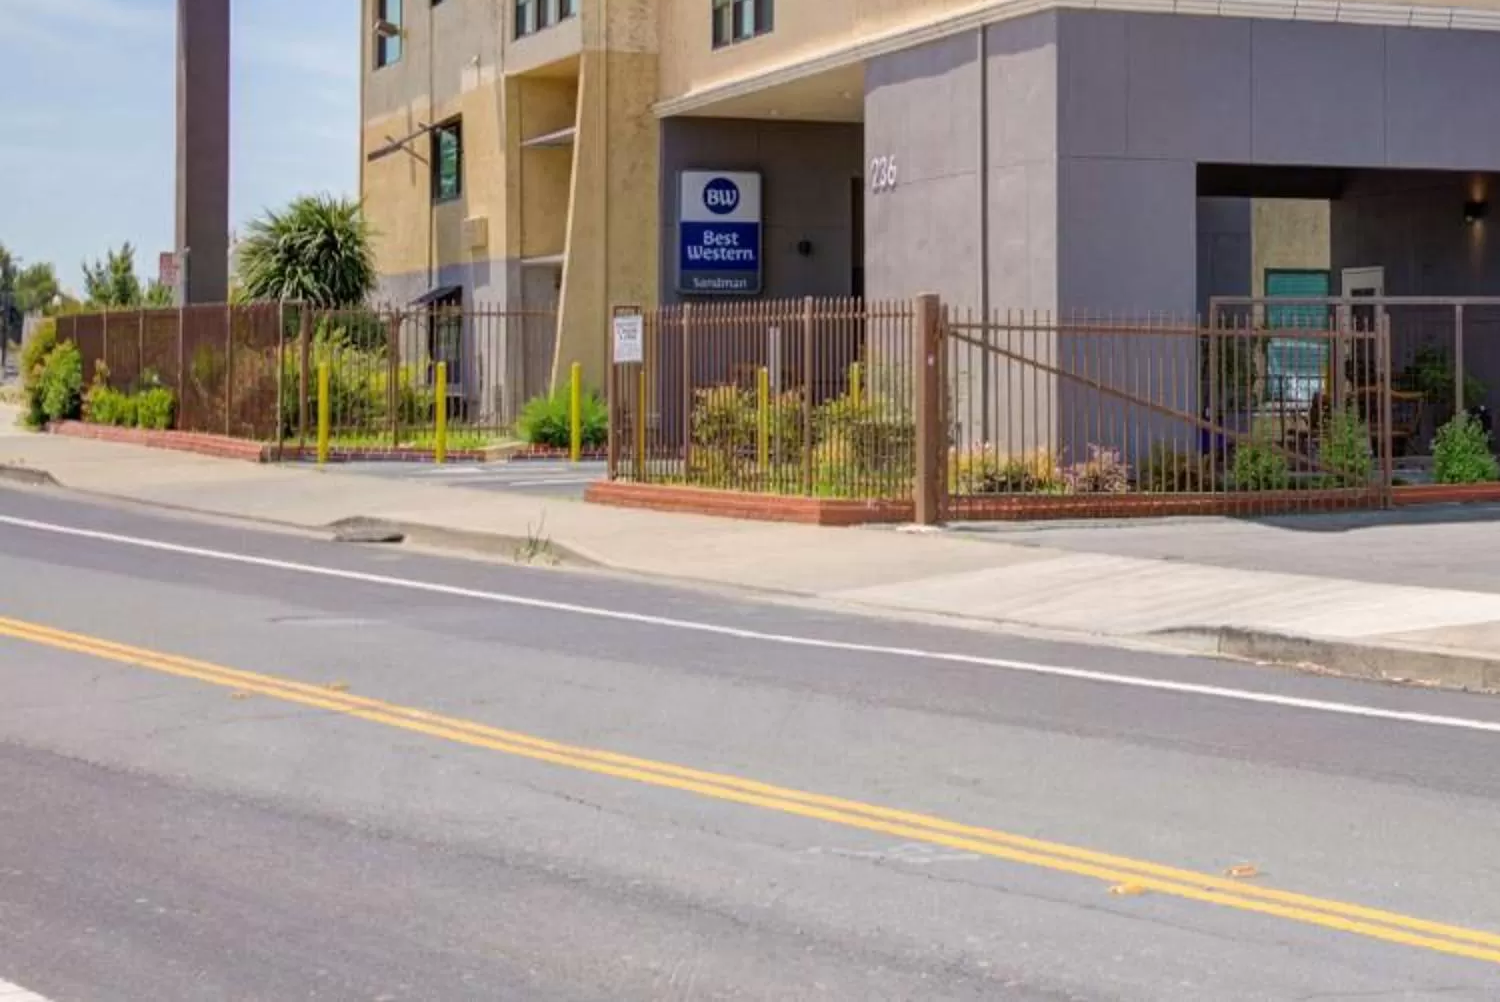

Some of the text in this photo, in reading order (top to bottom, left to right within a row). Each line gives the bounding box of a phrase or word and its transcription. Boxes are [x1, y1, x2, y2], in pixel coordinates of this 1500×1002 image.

[706, 187, 738, 207] BW
[702, 229, 740, 247] Best
[692, 277, 748, 289] Sandman
